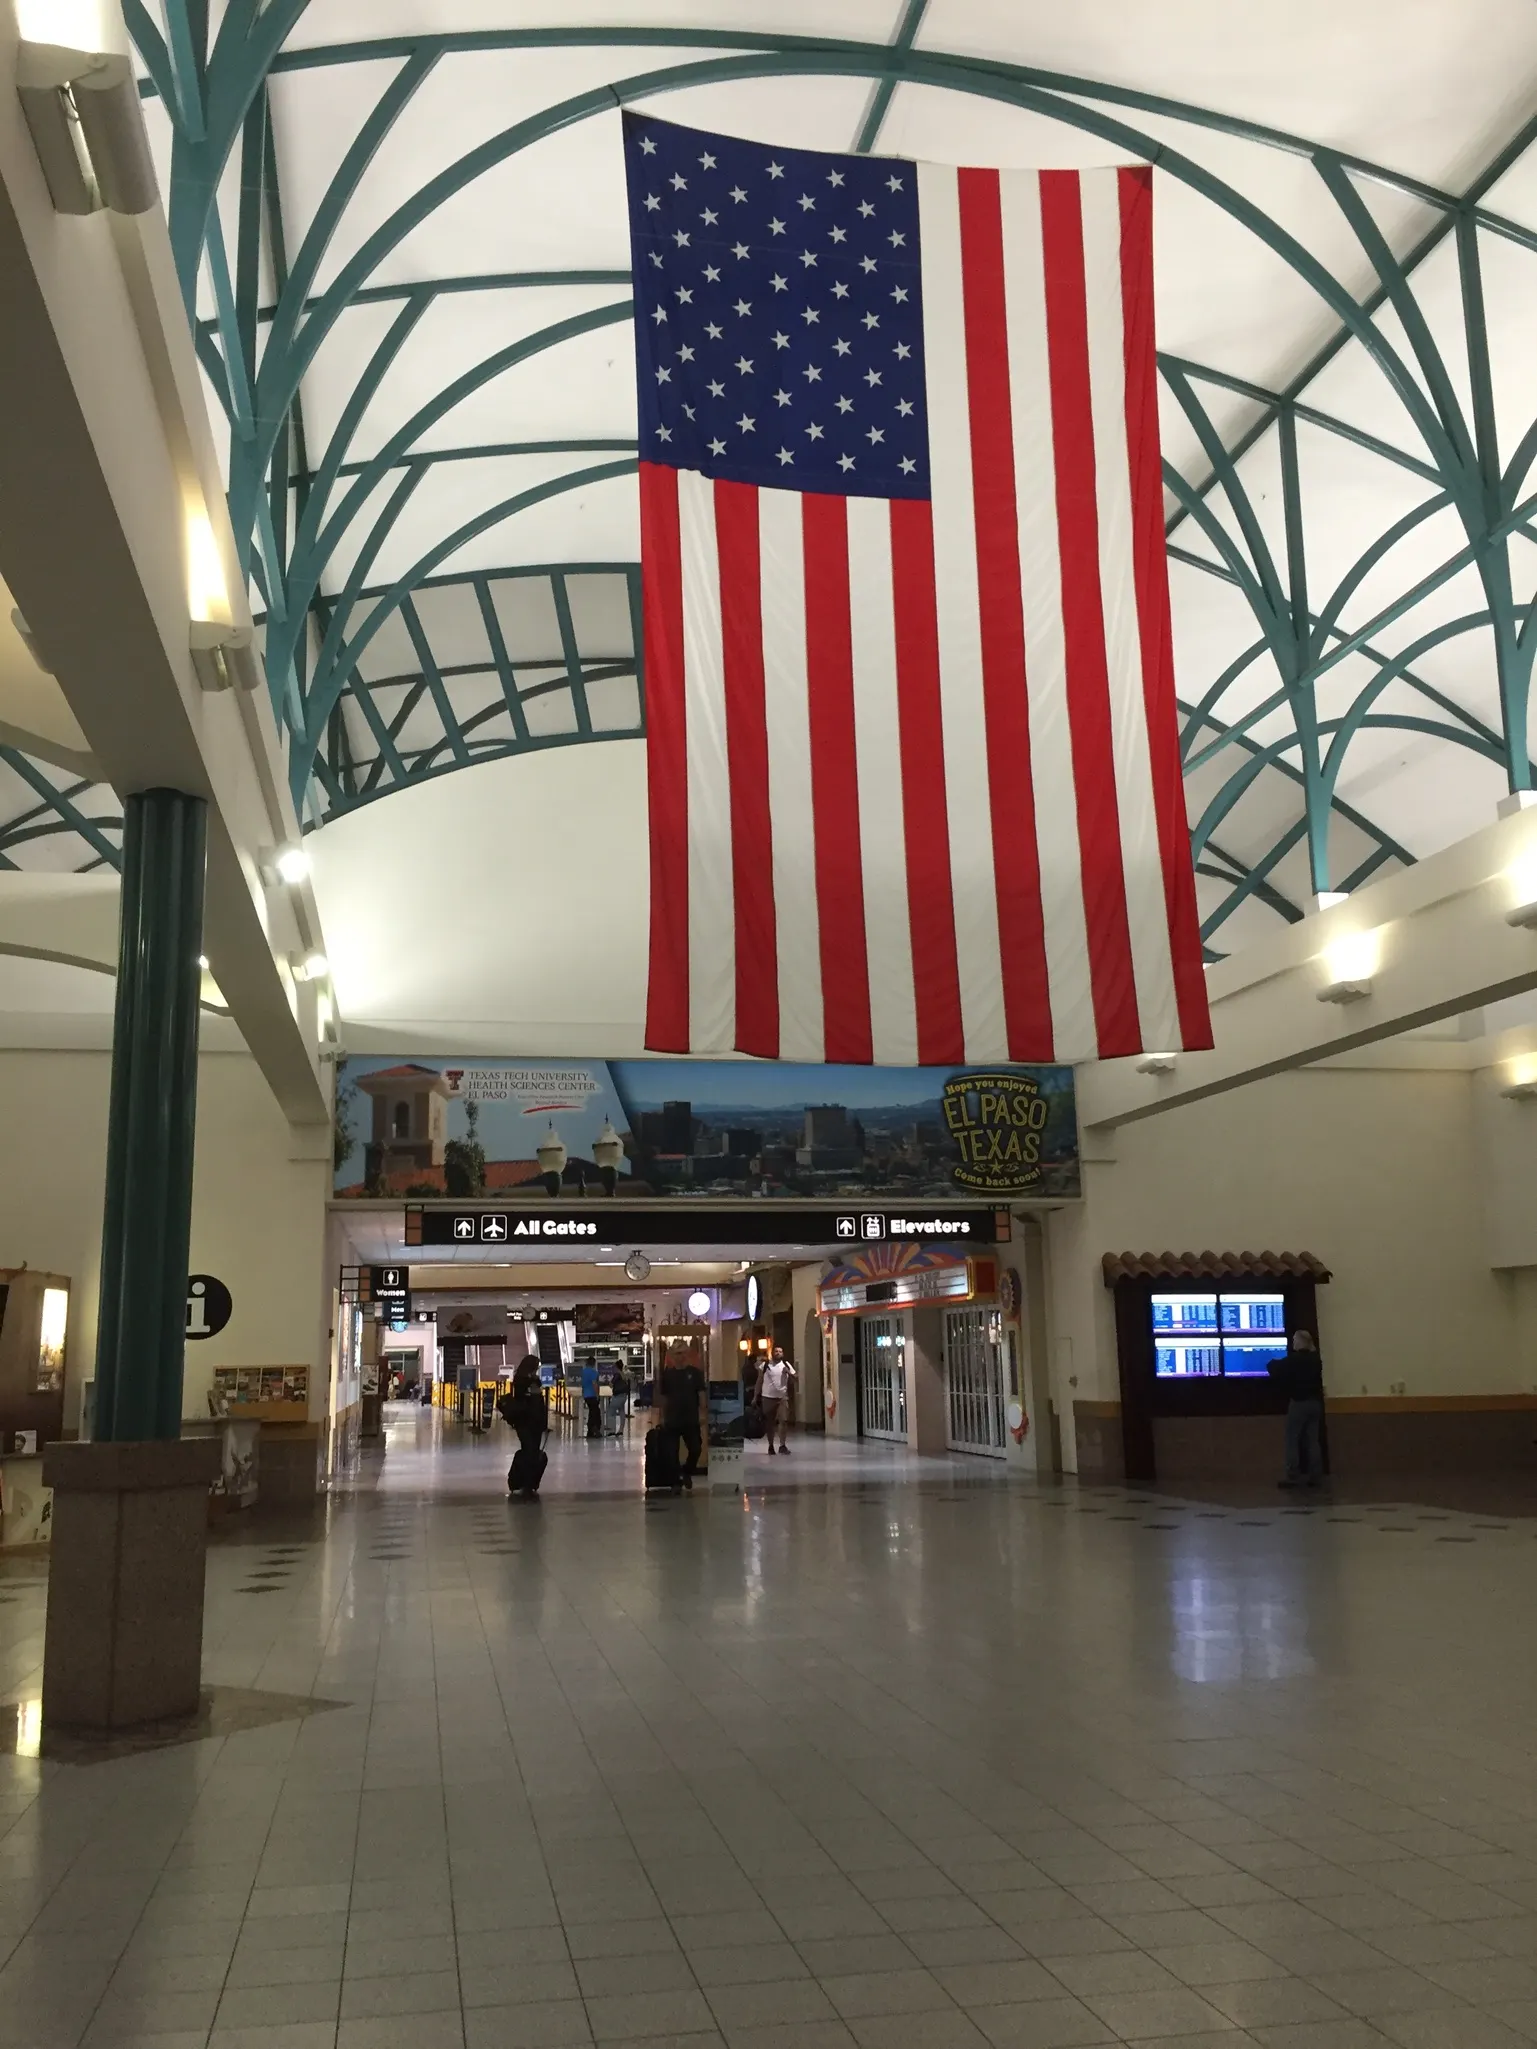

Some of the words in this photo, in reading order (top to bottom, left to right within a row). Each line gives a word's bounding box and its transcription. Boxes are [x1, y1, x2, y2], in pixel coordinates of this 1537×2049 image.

[469, 1071, 500, 1080] TEXAS
[504, 1071, 529, 1081] TECH
[531, 1072, 589, 1081] UNIVERSITY
[468, 1081, 508, 1090] HEALTH
[510, 1082, 555, 1090] SCIENCES
[558, 1082, 596, 1091] CENTER
[945, 1082, 973, 1095] Hope
[975, 1080, 995, 1090] you
[997, 1080, 1038, 1094] enjoyed
[468, 1091, 481, 1099] EL
[482, 1091, 507, 1100] PASO
[943, 1096, 976, 1129] EL
[980, 1094, 1047, 1129] PASO
[952, 1129, 1040, 1163] TEXAS
[954, 1168, 983, 1184] Come
[985, 1176, 1011, 1186] back
[1013, 1167, 1041, 1184] soon!
[514, 1220, 540, 1235] All
[542, 1220, 597, 1236] Gates
[890, 1219, 970, 1234] Elevators
[376, 1289, 406, 1297] Women
